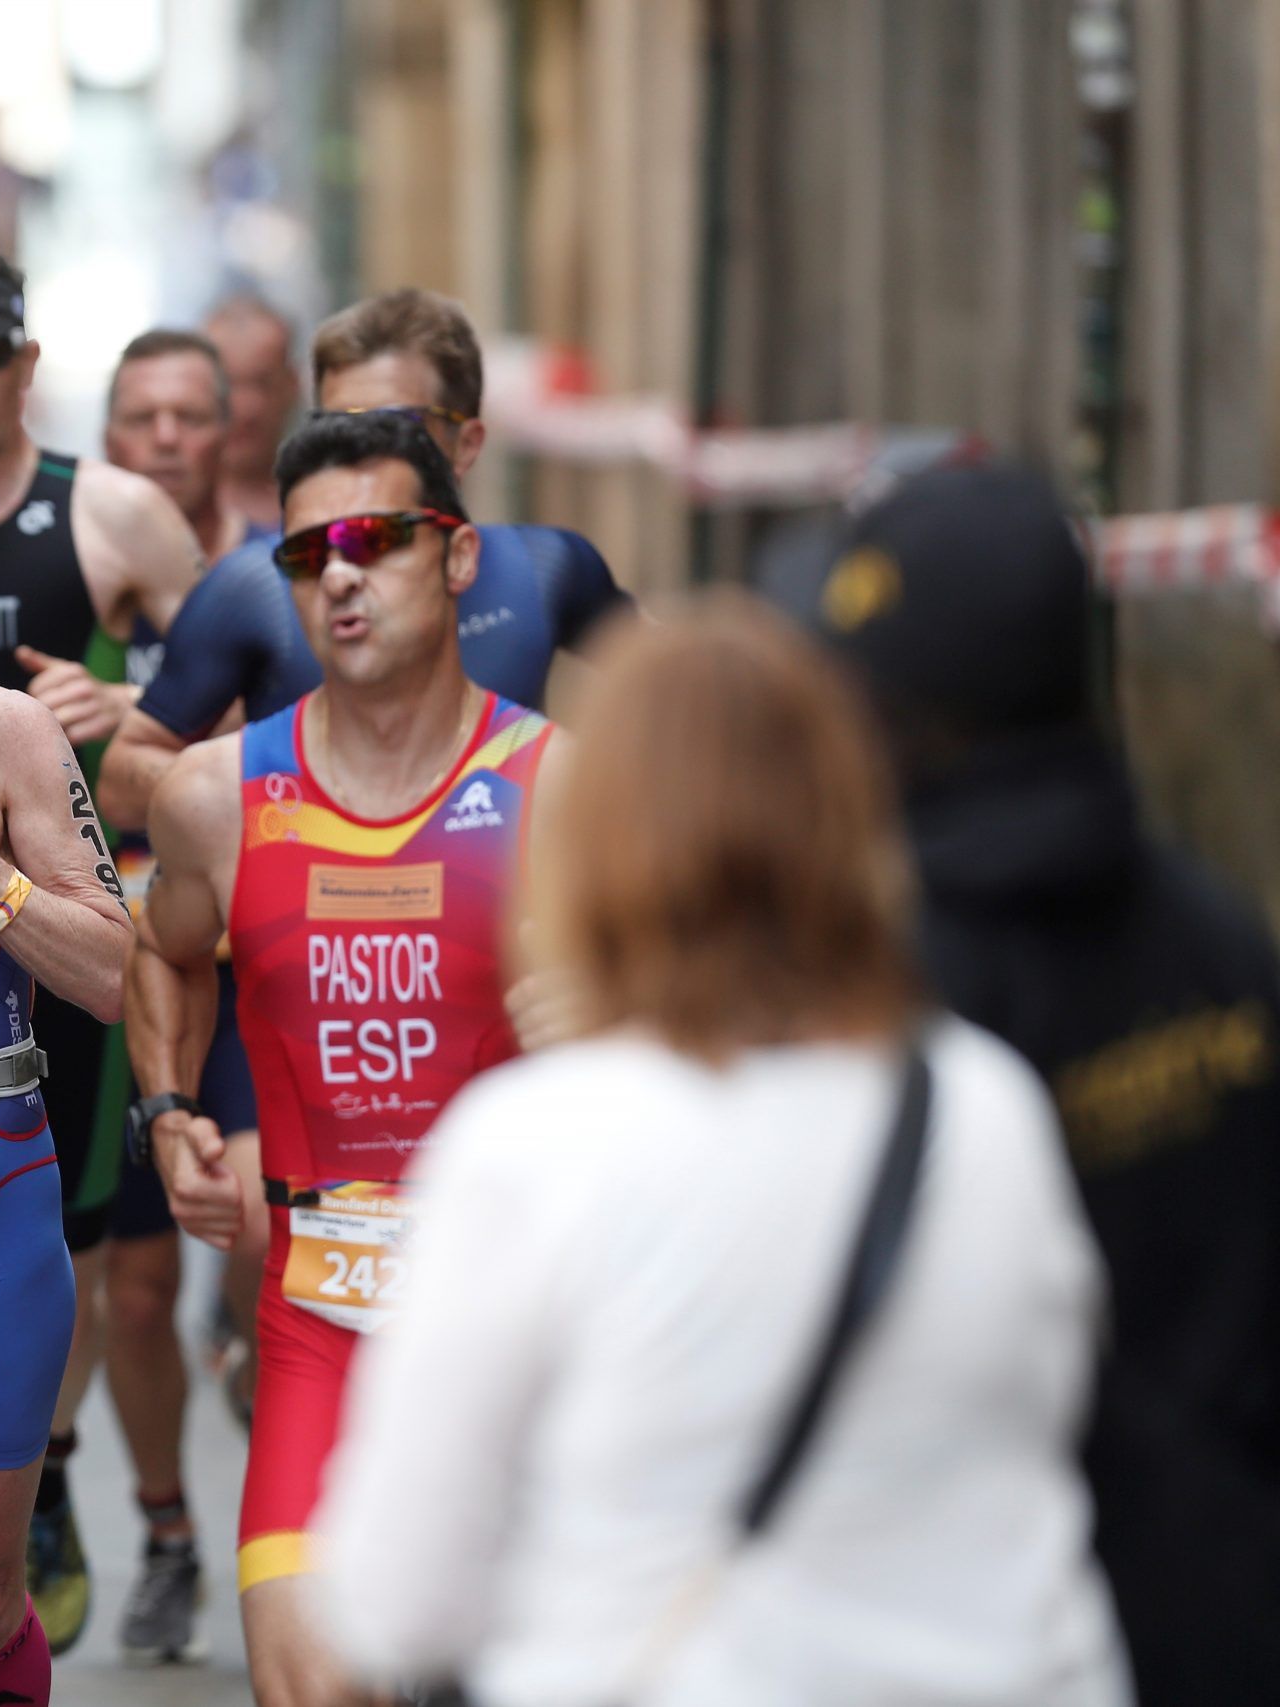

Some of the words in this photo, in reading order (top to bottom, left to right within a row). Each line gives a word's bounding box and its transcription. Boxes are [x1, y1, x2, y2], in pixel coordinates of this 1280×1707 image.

[70, 780, 132, 921] 219
[308, 932, 442, 1004] PASTOR
[318, 1018, 438, 1084] ESP
